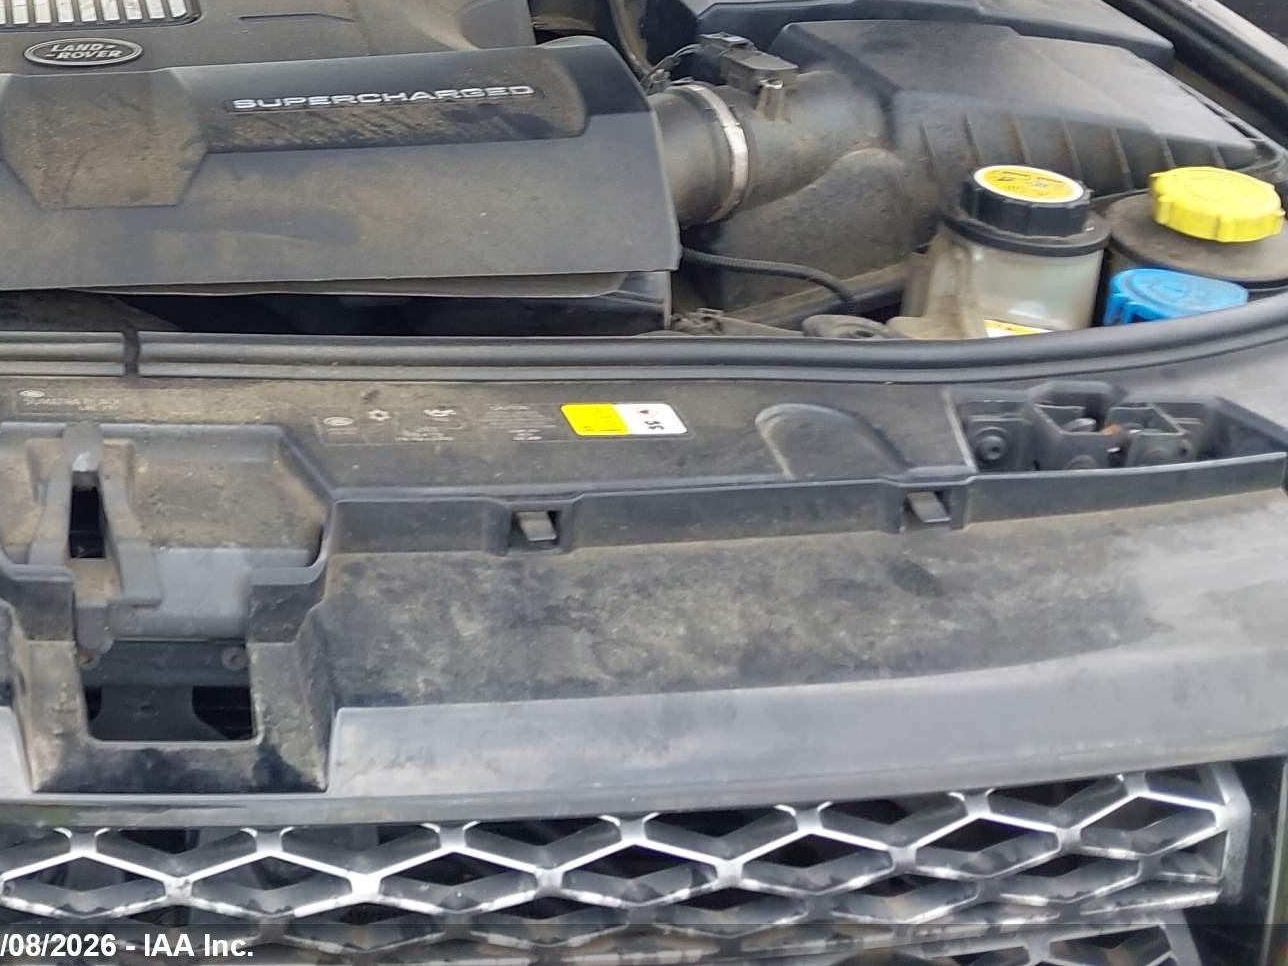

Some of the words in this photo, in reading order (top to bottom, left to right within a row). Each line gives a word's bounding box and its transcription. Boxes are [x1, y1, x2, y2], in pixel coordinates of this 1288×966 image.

[50, 43, 103, 52] LAND
[55, 49, 123, 59] ROVER
[231, 85, 536, 110] SUPERCHARGED
